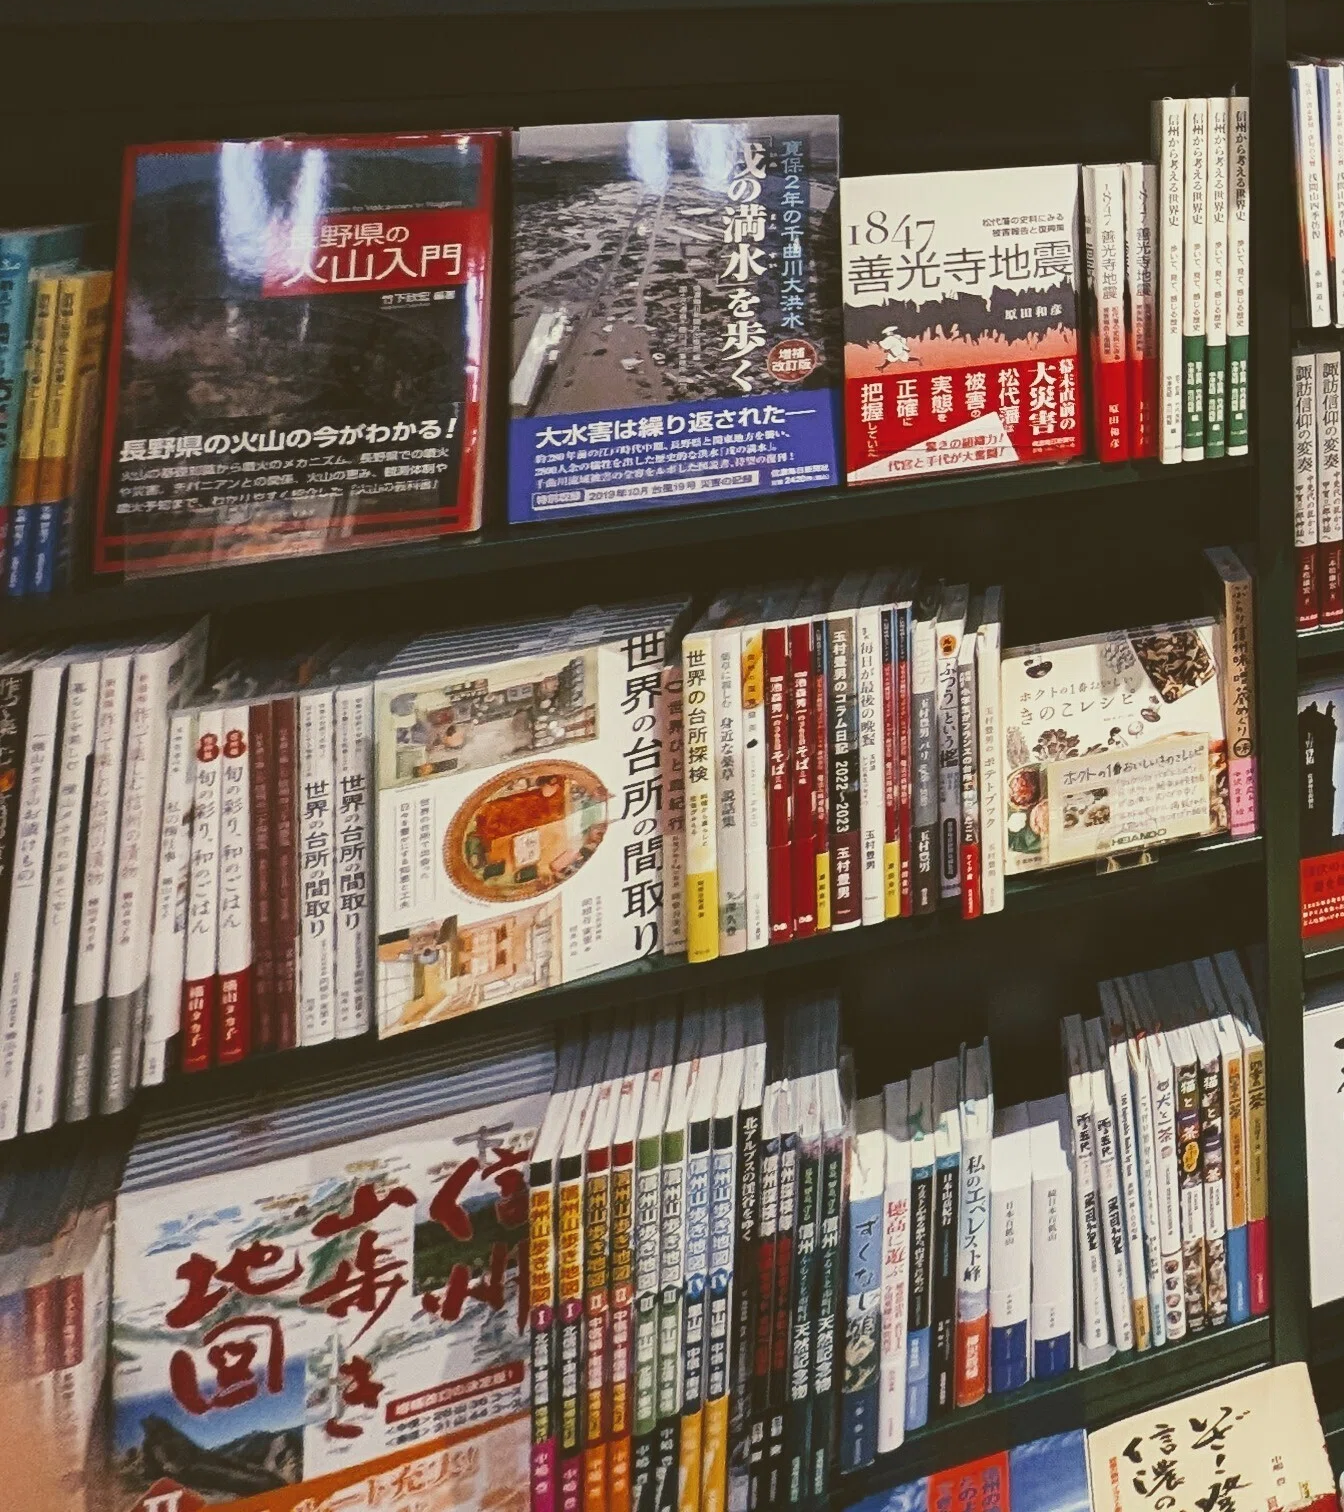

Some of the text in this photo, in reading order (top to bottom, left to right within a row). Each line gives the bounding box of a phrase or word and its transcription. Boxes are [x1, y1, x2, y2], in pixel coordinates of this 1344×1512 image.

[1168, 113, 1180, 228] 信州から考える世界史
[781, 139, 804, 329] 寛保2年の千曲川大洪水
[847, 209, 936, 251] 1847
[981, 211, 1065, 228] 松代藩の史料にみる
[282, 243, 464, 288] 火山入門
[848, 238, 1073, 296] 善光寺地震
[1101, 230, 1117, 300] 善光寺地震
[1004, 302, 1063, 322] 原田和彦
[771, 347, 814, 373] 増補 改訂版
[1058, 357, 1077, 431] 幕末直前の
[895, 378, 919, 428] 正確に
[930, 374, 954, 423] 実態を
[964, 372, 987, 419] 被害の
[1028, 361, 1058, 435] 大災害
[1295, 365, 1314, 472] 諏訪信仰の変奏
[1321, 362, 1339, 470] 諏訪信仰の変奏
[118, 418, 457, 463] 長野県の火山の今がわかる!
[685, 648, 710, 785] 世界の台所探検
[860, 640, 877, 748] 毎日が最後の晩餐
[1020, 689, 1135, 726] きのこレシピ
[304, 780, 330, 939] 世界の台所の間取り
[339, 774, 367, 930] 世界の台所の間取り
[836, 846, 850, 899] 玉村豊男
[962, 1155, 988, 1284] 私のエベレスト峰
[1004, 1200, 1015, 1246] 日本百低山
[166, 1241, 305, 1416] 地図
[300, 1183, 418, 1440] 山歩き
